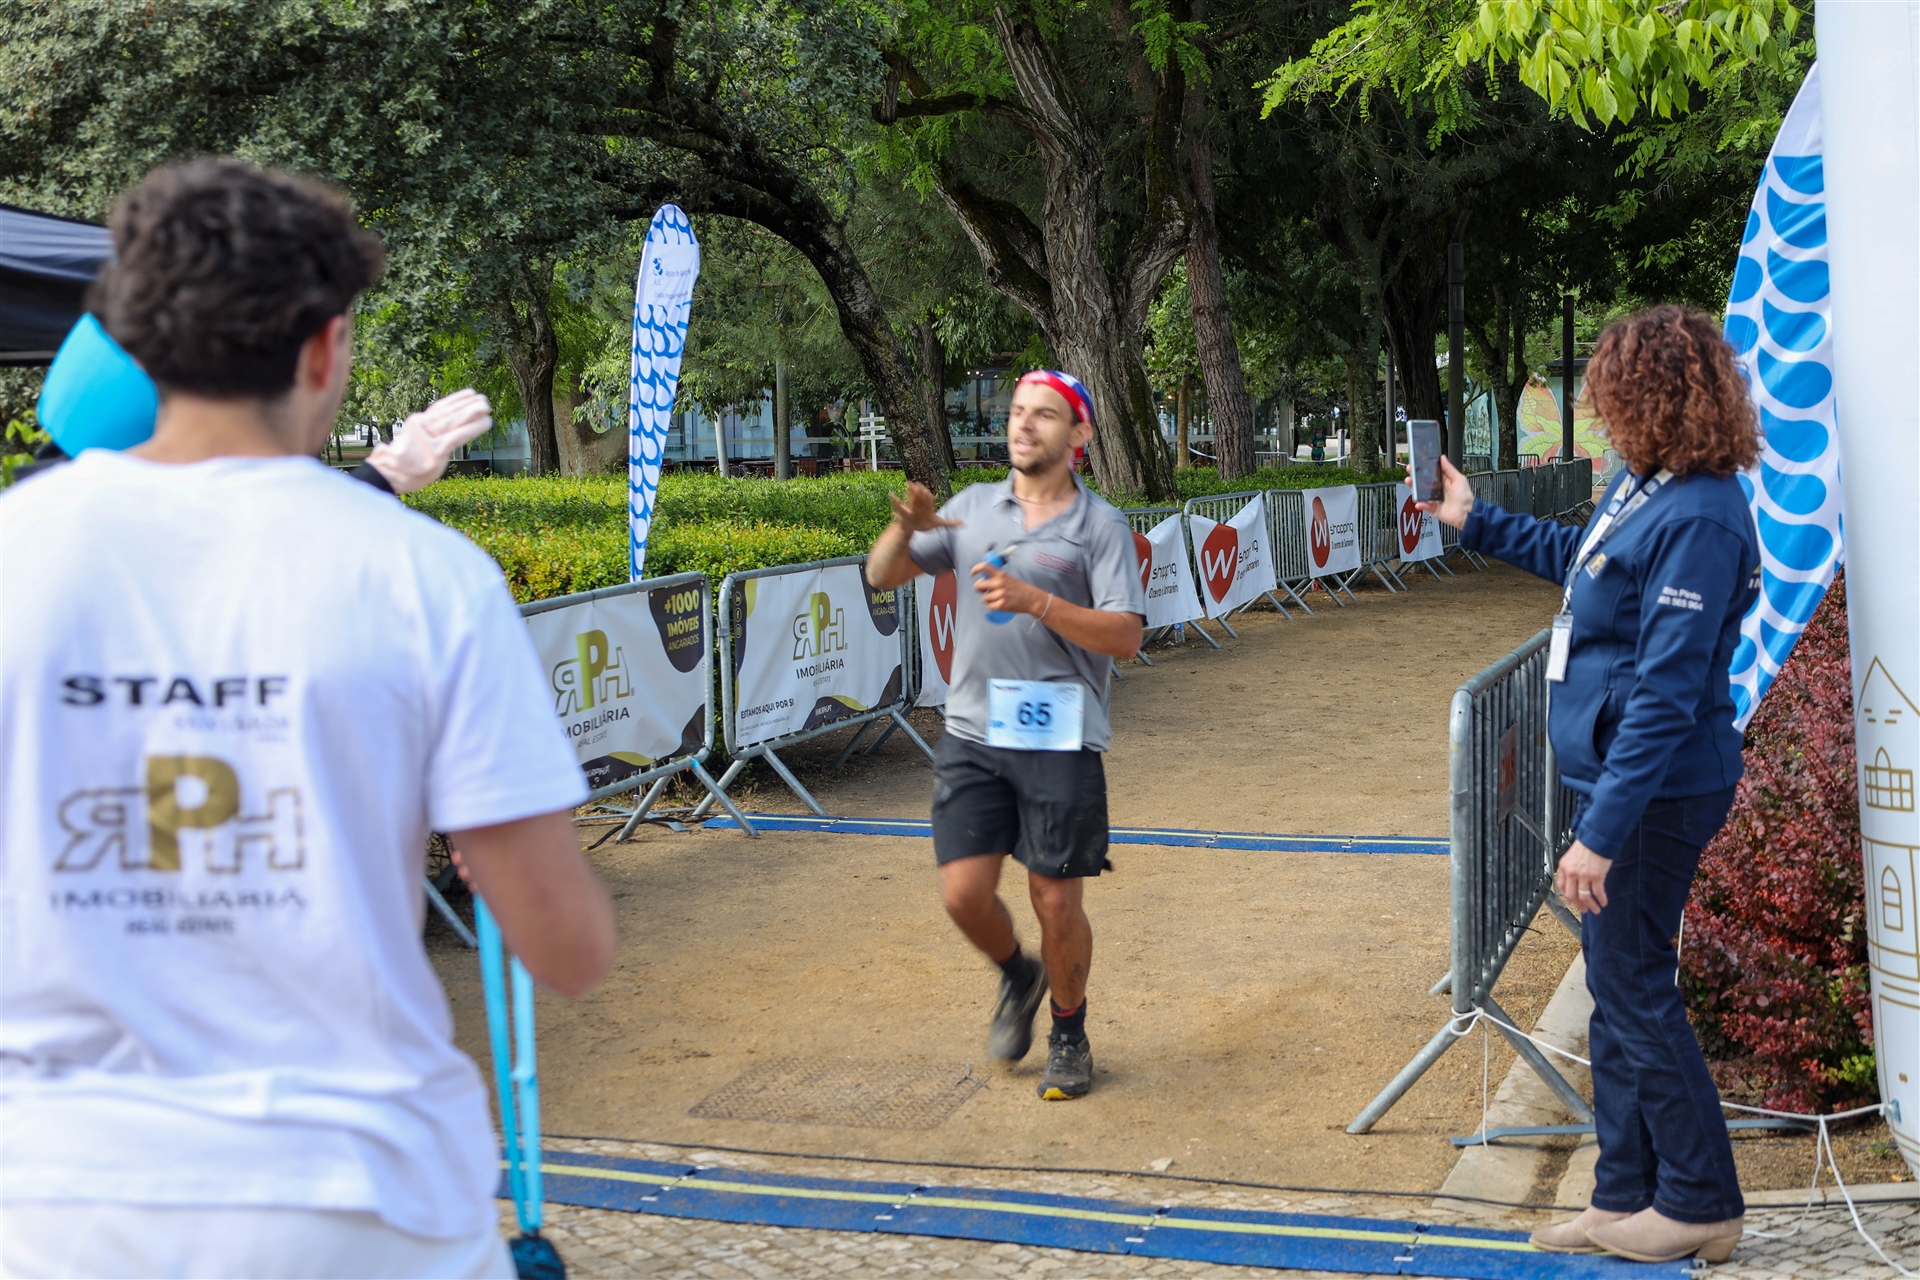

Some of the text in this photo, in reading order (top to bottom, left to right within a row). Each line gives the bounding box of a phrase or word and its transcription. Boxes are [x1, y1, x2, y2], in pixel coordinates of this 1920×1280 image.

[1314, 518, 1328, 548] W
[1330, 521, 1354, 535] shopping
[1204, 545, 1236, 582] W
[664, 589, 700, 615] +1000
[666, 615, 700, 638] IMÓVEIS
[667, 633, 700, 652] ANGARIADOS
[60, 675, 290, 708] STAFF
[740, 697, 795, 719] ESTAMOS AQUI POR SI
[1017, 701, 1053, 728] 65
[562, 707, 630, 739] MOBILIÁRIA
